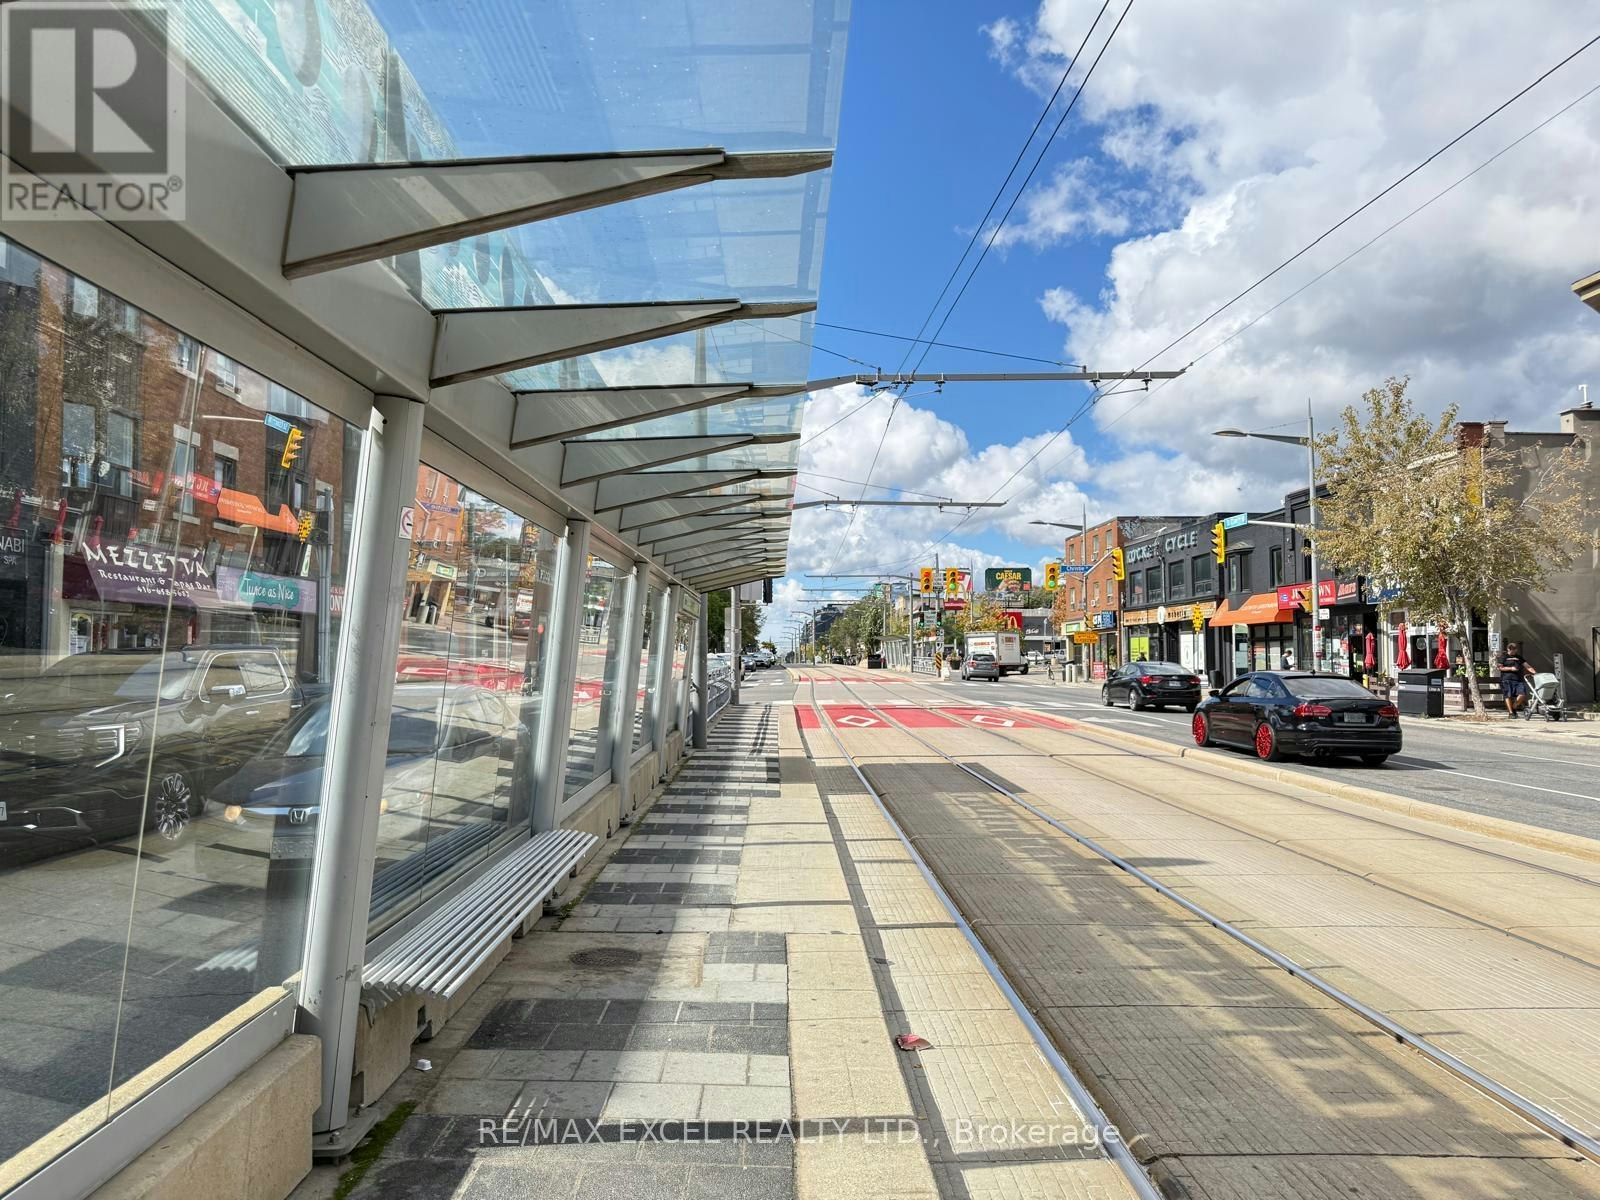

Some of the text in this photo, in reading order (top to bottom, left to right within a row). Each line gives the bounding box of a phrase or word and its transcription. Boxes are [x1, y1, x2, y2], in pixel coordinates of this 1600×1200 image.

[1165, 530, 1198, 552] CYCLE
[98, 569, 156, 586] Restaurant
[196, 582, 211, 591] Bar
[995, 572, 1022, 581] CAESAR
[244, 578, 294, 601] Twice as Nice
